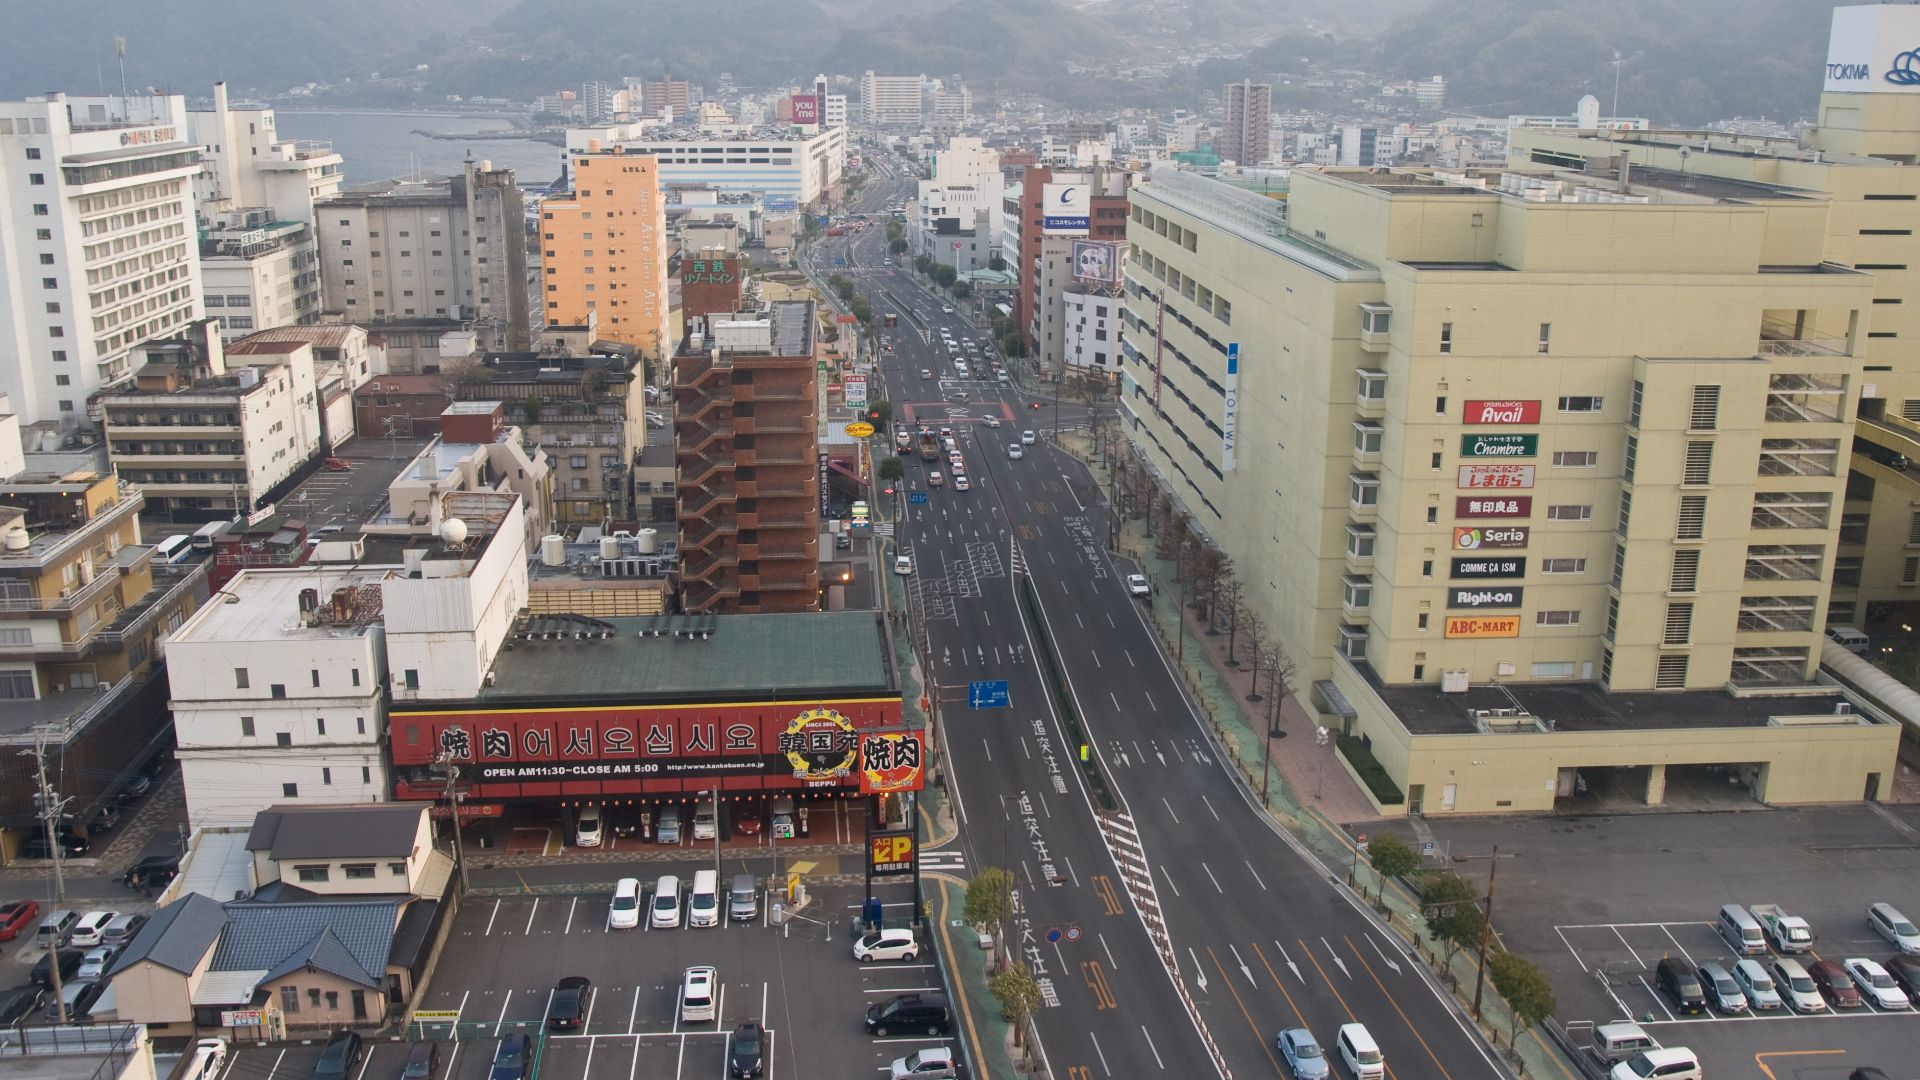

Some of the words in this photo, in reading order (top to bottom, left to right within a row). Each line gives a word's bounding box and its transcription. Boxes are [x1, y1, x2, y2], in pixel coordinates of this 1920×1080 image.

[1826, 63, 1870, 80] TOKIWA
[795, 101, 813, 112] you
[799, 109, 814, 118] me
[685, 273, 734, 285] リゾートイン
[1225, 388, 1236, 451] TOKIWA
[1481, 407, 1524, 423] Avail
[1474, 442, 1525, 455] Chambre
[1469, 473, 1524, 487] しまむら
[1469, 500, 1519, 513] 無印良品
[1485, 528, 1524, 542] Seria
[1460, 563, 1487, 573] COMME
[1489, 563, 1499, 574] ÇA
[1501, 562, 1516, 572] ISM
[1457, 591, 1513, 606] Right-on
[1449, 620, 1515, 634] ABC-MART
[440, 728, 512, 760] 焼肉
[523, 723, 756, 755] 어서오십시요
[779, 730, 859, 755] 韓国苑
[863, 735, 920, 771] 焼肉
[1030, 719, 1068, 794] 追突注意
[484, 768, 516, 777] OPEN
[614, 765, 631, 773] AM
[634, 764, 658, 773] 5:00
[809, 780, 836, 788] BEPPU
[1018, 790, 1063, 888] 追突注意
[892, 837, 911, 862] P
[875, 862, 910, 872] 専用駐車場
